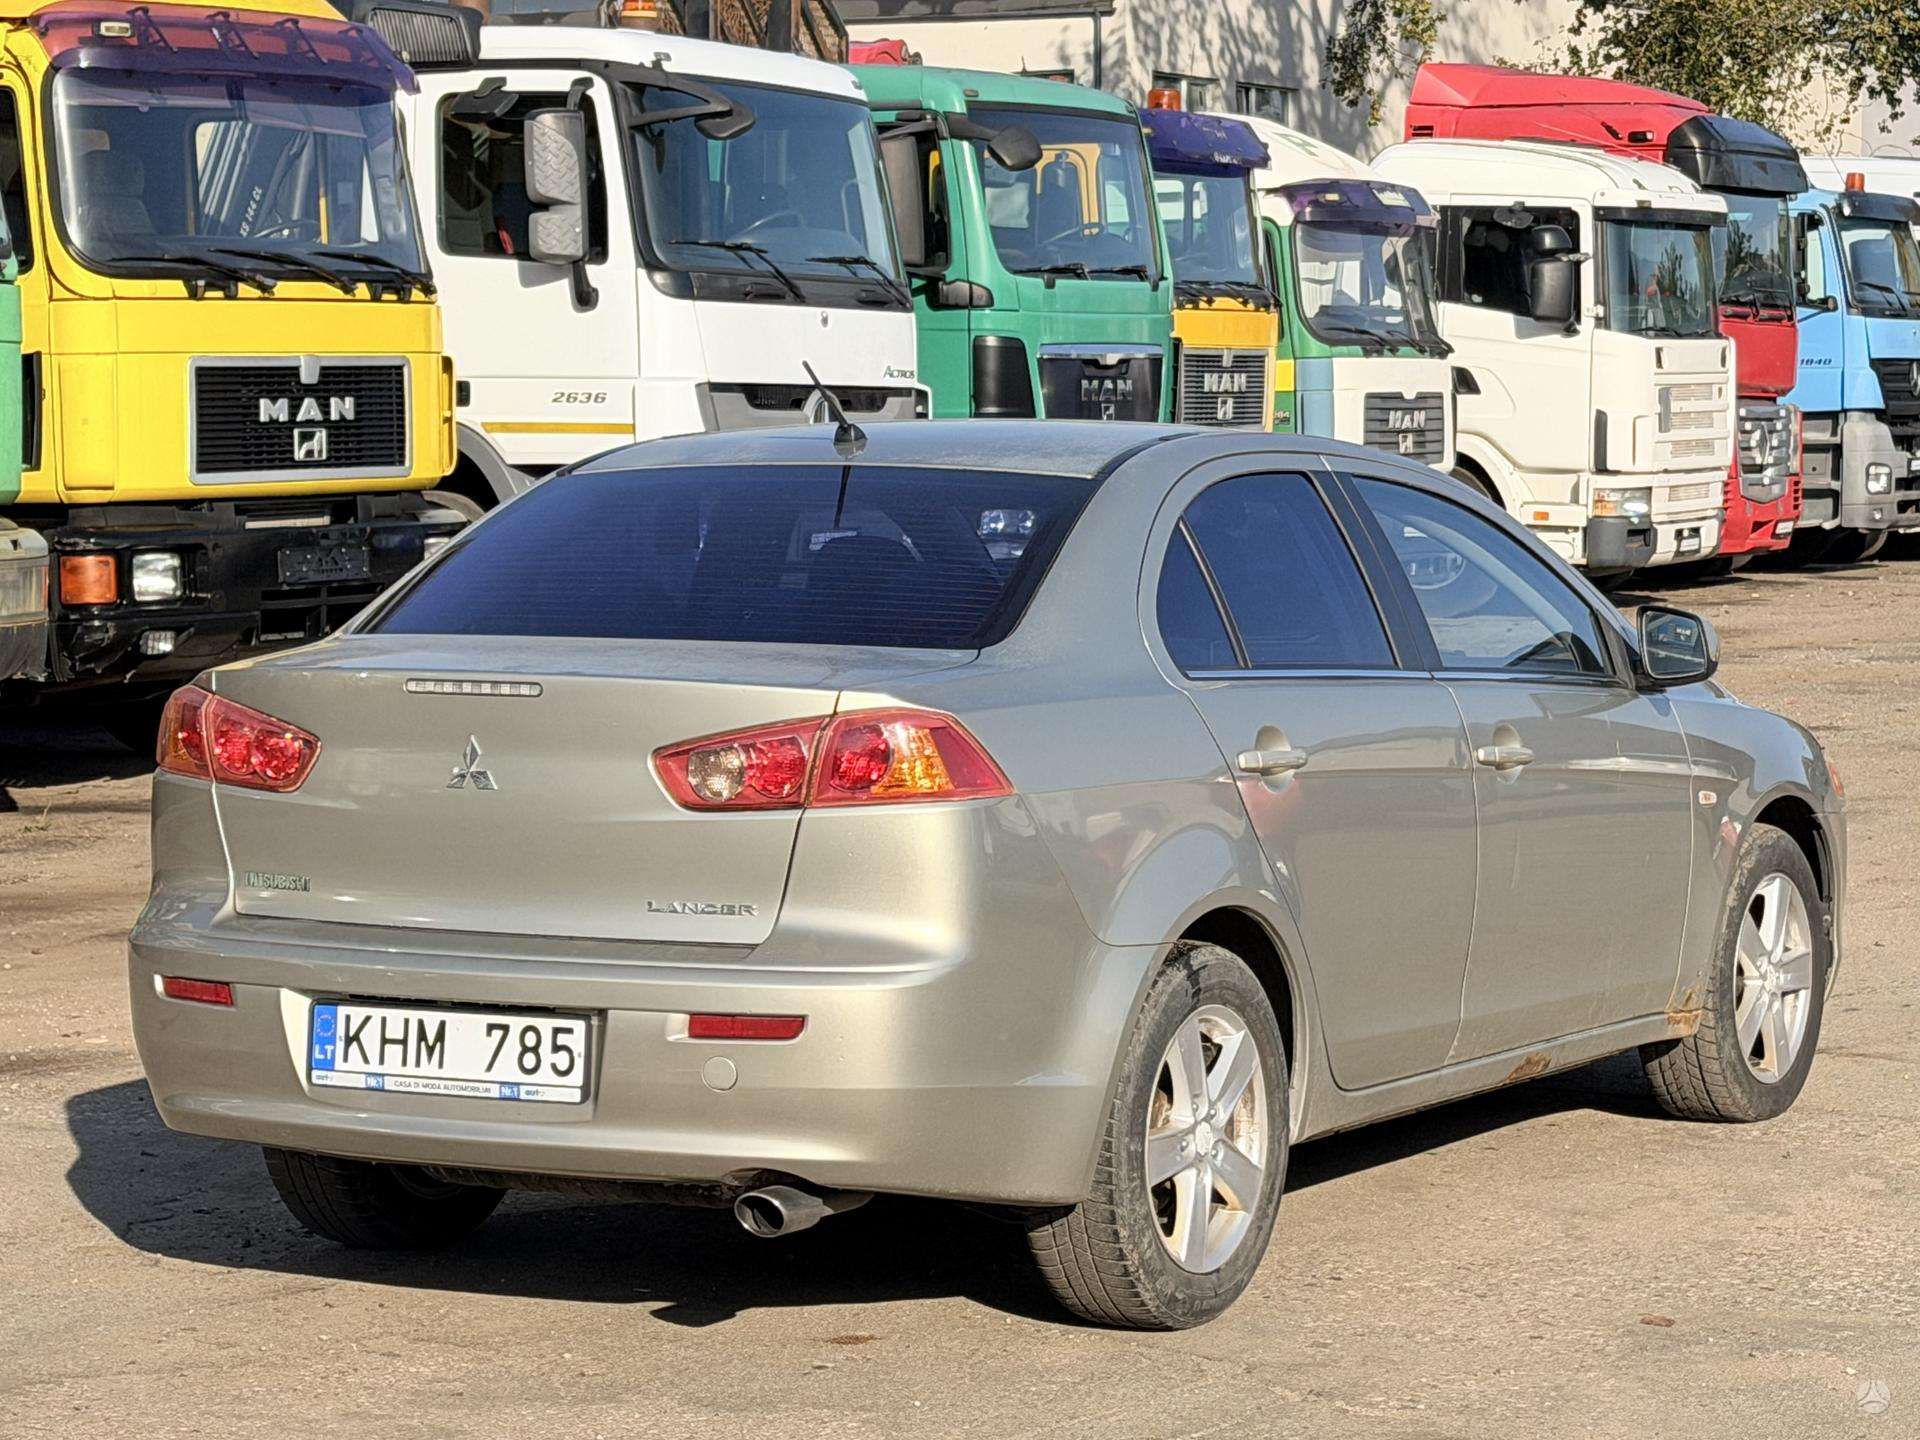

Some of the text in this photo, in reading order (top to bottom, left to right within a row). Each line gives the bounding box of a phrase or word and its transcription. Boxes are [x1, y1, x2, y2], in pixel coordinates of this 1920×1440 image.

[1081, 379, 1133, 401] MAN
[1203, 373, 1247, 393] MAN
[551, 391, 608, 404] 2636
[259, 397, 355, 422] MAN
[1388, 410, 1426, 430] MAN
[646, 900, 759, 917] LANCER
[314, 1044, 335, 1060] LT
[342, 1013, 576, 1077] KHM 785
[394, 1080, 412, 1089] CASA
